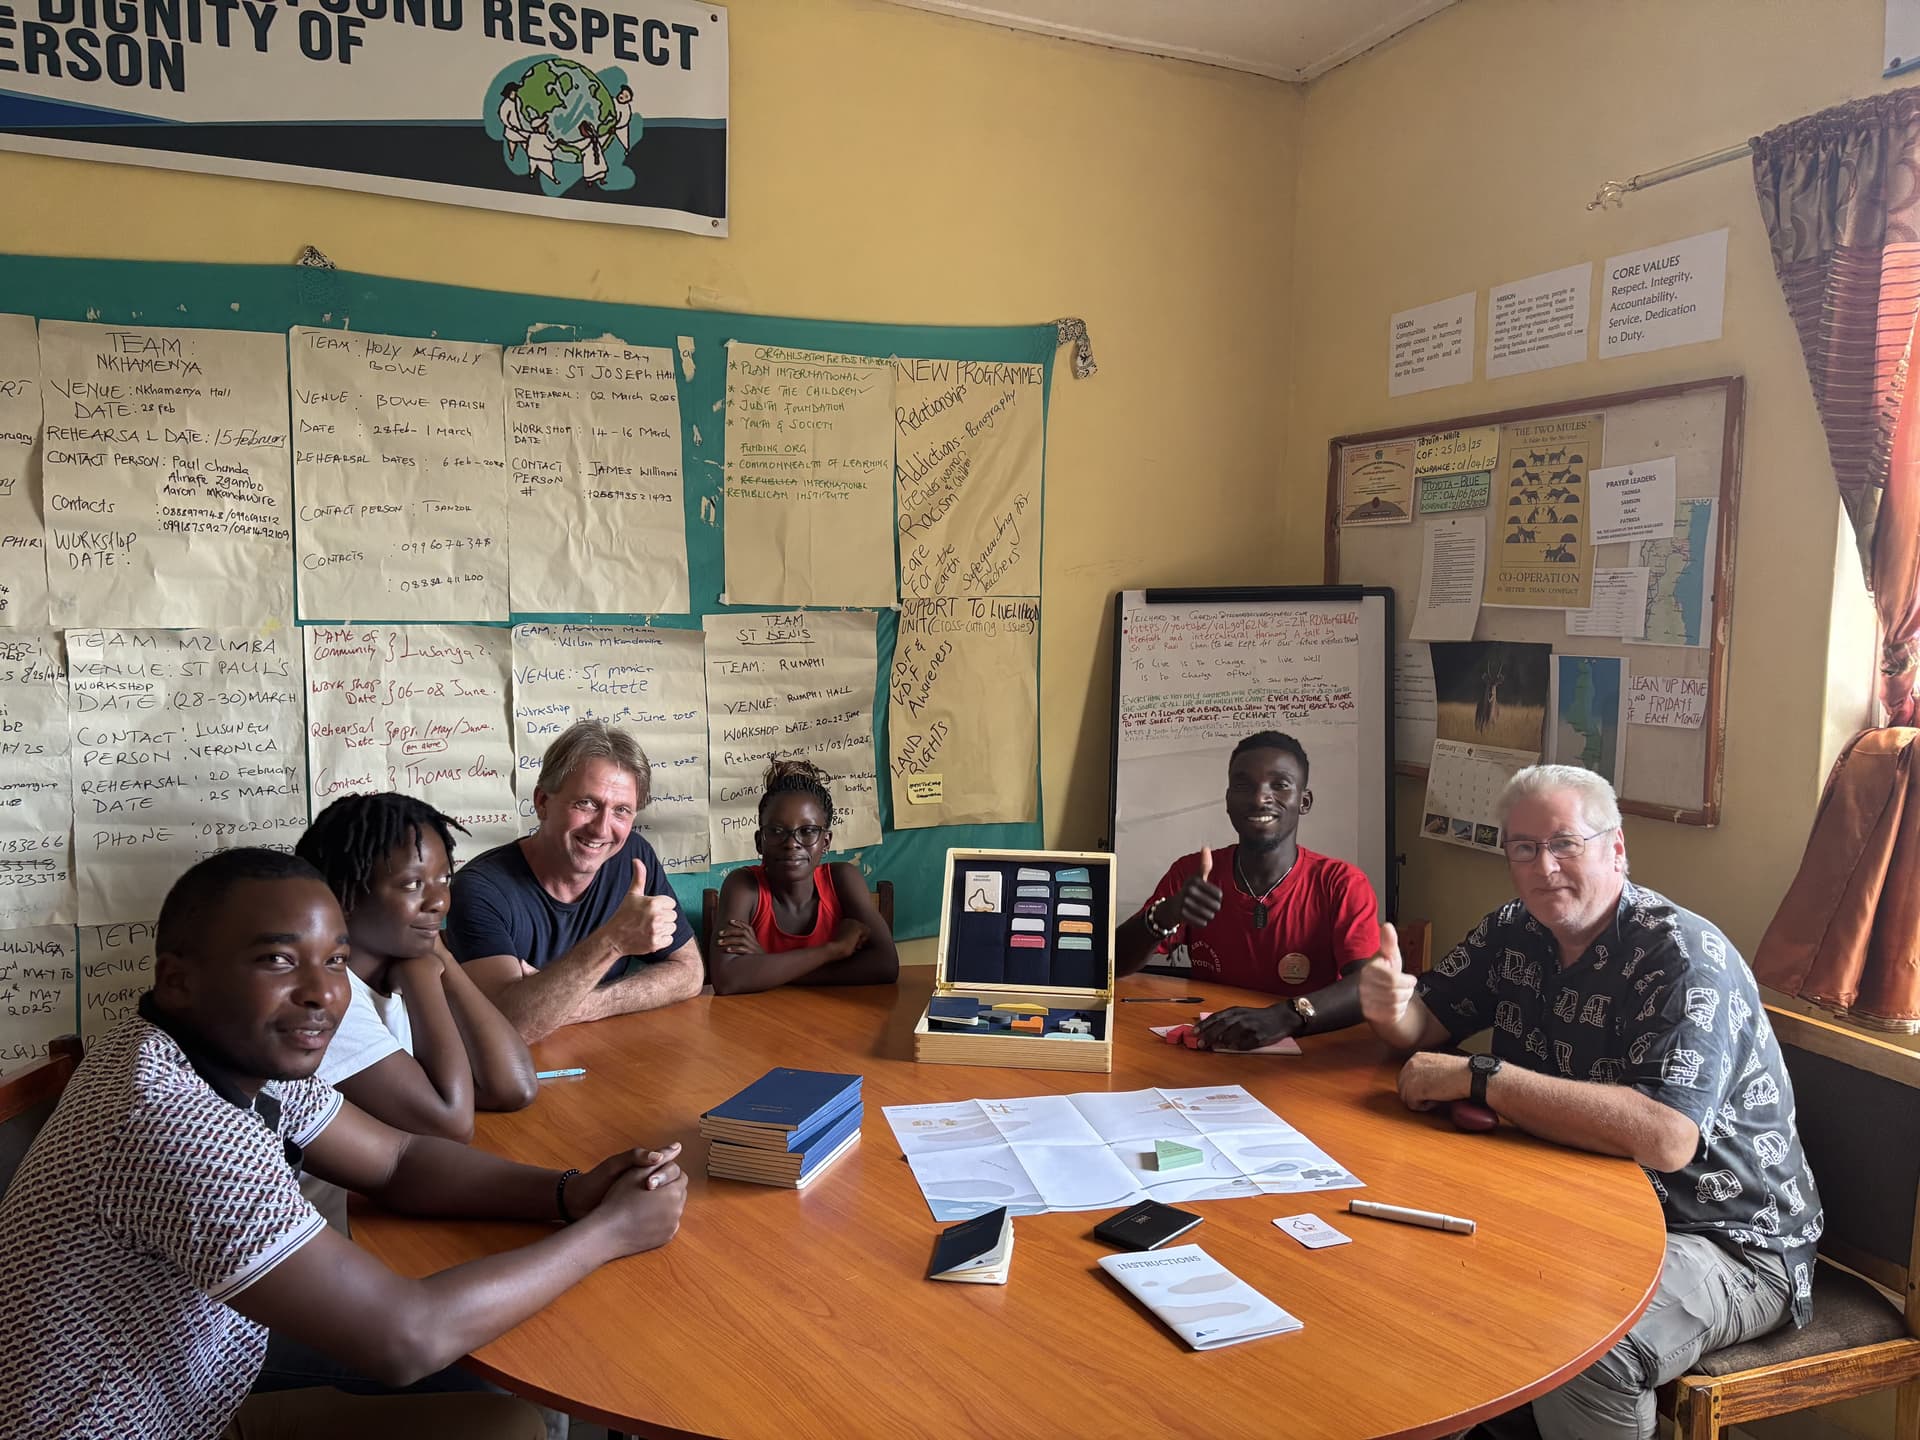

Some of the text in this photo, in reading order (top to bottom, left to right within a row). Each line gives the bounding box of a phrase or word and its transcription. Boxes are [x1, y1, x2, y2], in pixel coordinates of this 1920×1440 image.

[299, 9, 366, 64] OF
[484, 0, 698, 69] RESPECT
[1612, 255, 1680, 280] CORE VALUES
[1645, 304, 1696, 321] Dedication
[1608, 331, 1644, 344] to Duty.
[366, 339, 401, 358] HOLY
[370, 361, 428, 376] BOWE
[566, 365, 584, 378] ST
[896, 360, 949, 383] NEW
[956, 360, 1042, 386] PROGRAMMES
[210, 387, 231, 397] Hall
[741, 384, 857, 396] SAVE THE CHILDREN
[377, 395, 430, 409] BOWE
[440, 401, 485, 410] PARISH
[895, 384, 967, 436] Relationships
[1535, 425, 1554, 434] TWO
[515, 436, 541, 444] DATE
[896, 390, 1015, 491] Addictions Pornography
[785, 444, 806, 454] ORG
[48, 451, 107, 465] CONTACT
[512, 458, 562, 470] CONTACT
[1606, 475, 1656, 488] PRAYER LEADERS
[300, 505, 354, 521] CONTACT
[900, 493, 960, 540] Racism
[1498, 572, 1580, 584] CO-OPERATION
[903, 597, 958, 618] SUPPORT
[968, 598, 985, 618] TO
[761, 615, 804, 627] TEAM
[736, 629, 756, 642] ST
[181, 661, 209, 676] ST
[779, 658, 825, 671] RUMPHI
[908, 639, 953, 719] Awareness
[1629, 676, 1658, 692] LEAN
[75, 682, 154, 693] WORKSHOP
[826, 685, 852, 697] HALL
[249, 693, 296, 704] MARCH
[1233, 710, 1310, 720] ECKHART TOLLE
[1645, 713, 1669, 723] EACH
[312, 717, 374, 737] Rehearsal
[724, 725, 779, 742] WORKSHOP
[909, 721, 948, 775] RIGHTS
[891, 735, 922, 779] LAND
[93, 799, 153, 814] DATE
[239, 784, 300, 797] MARCH
[93, 827, 175, 850] PHONE
[1118, 1255, 1201, 1270] INSTRUCTIONS
